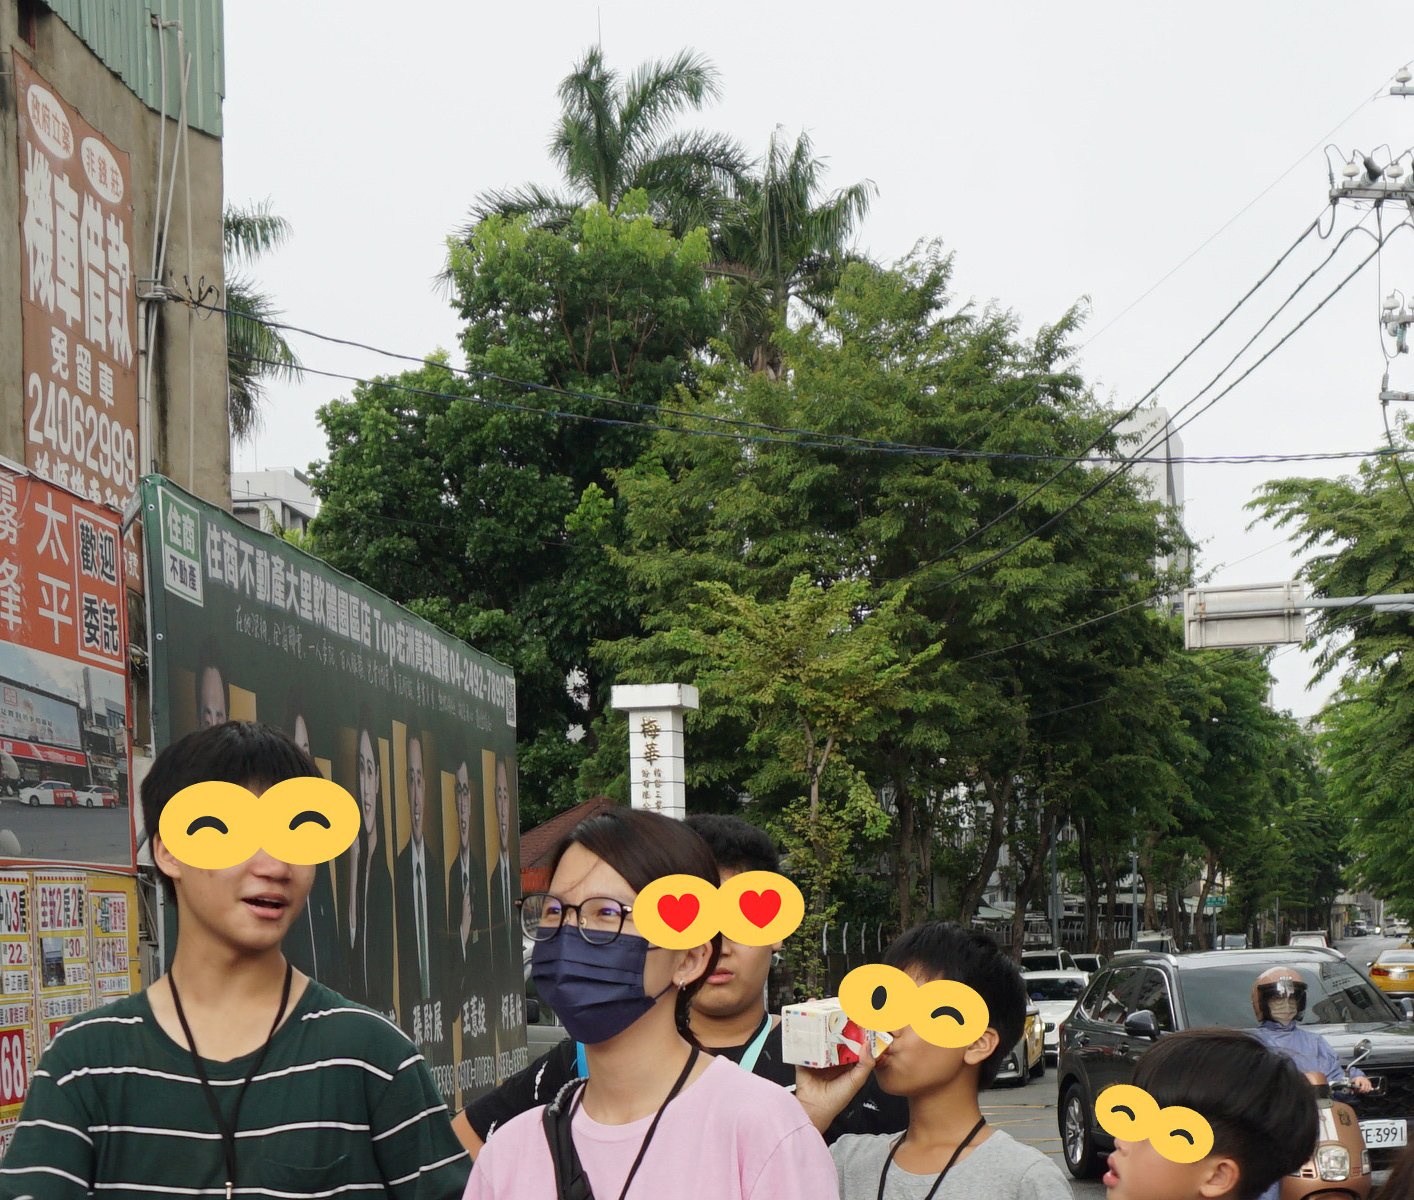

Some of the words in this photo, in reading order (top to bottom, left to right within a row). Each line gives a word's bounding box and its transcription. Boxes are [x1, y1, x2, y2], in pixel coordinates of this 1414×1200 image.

[24, 142, 133, 369] 機車借款
[50, 325, 115, 408] 免留車
[28, 372, 137, 493] 24062999
[78, 519, 118, 586] 歡迎
[166, 500, 196, 556] 住商
[169, 553, 198, 593] 不動產
[82, 596, 121, 656] 委託
